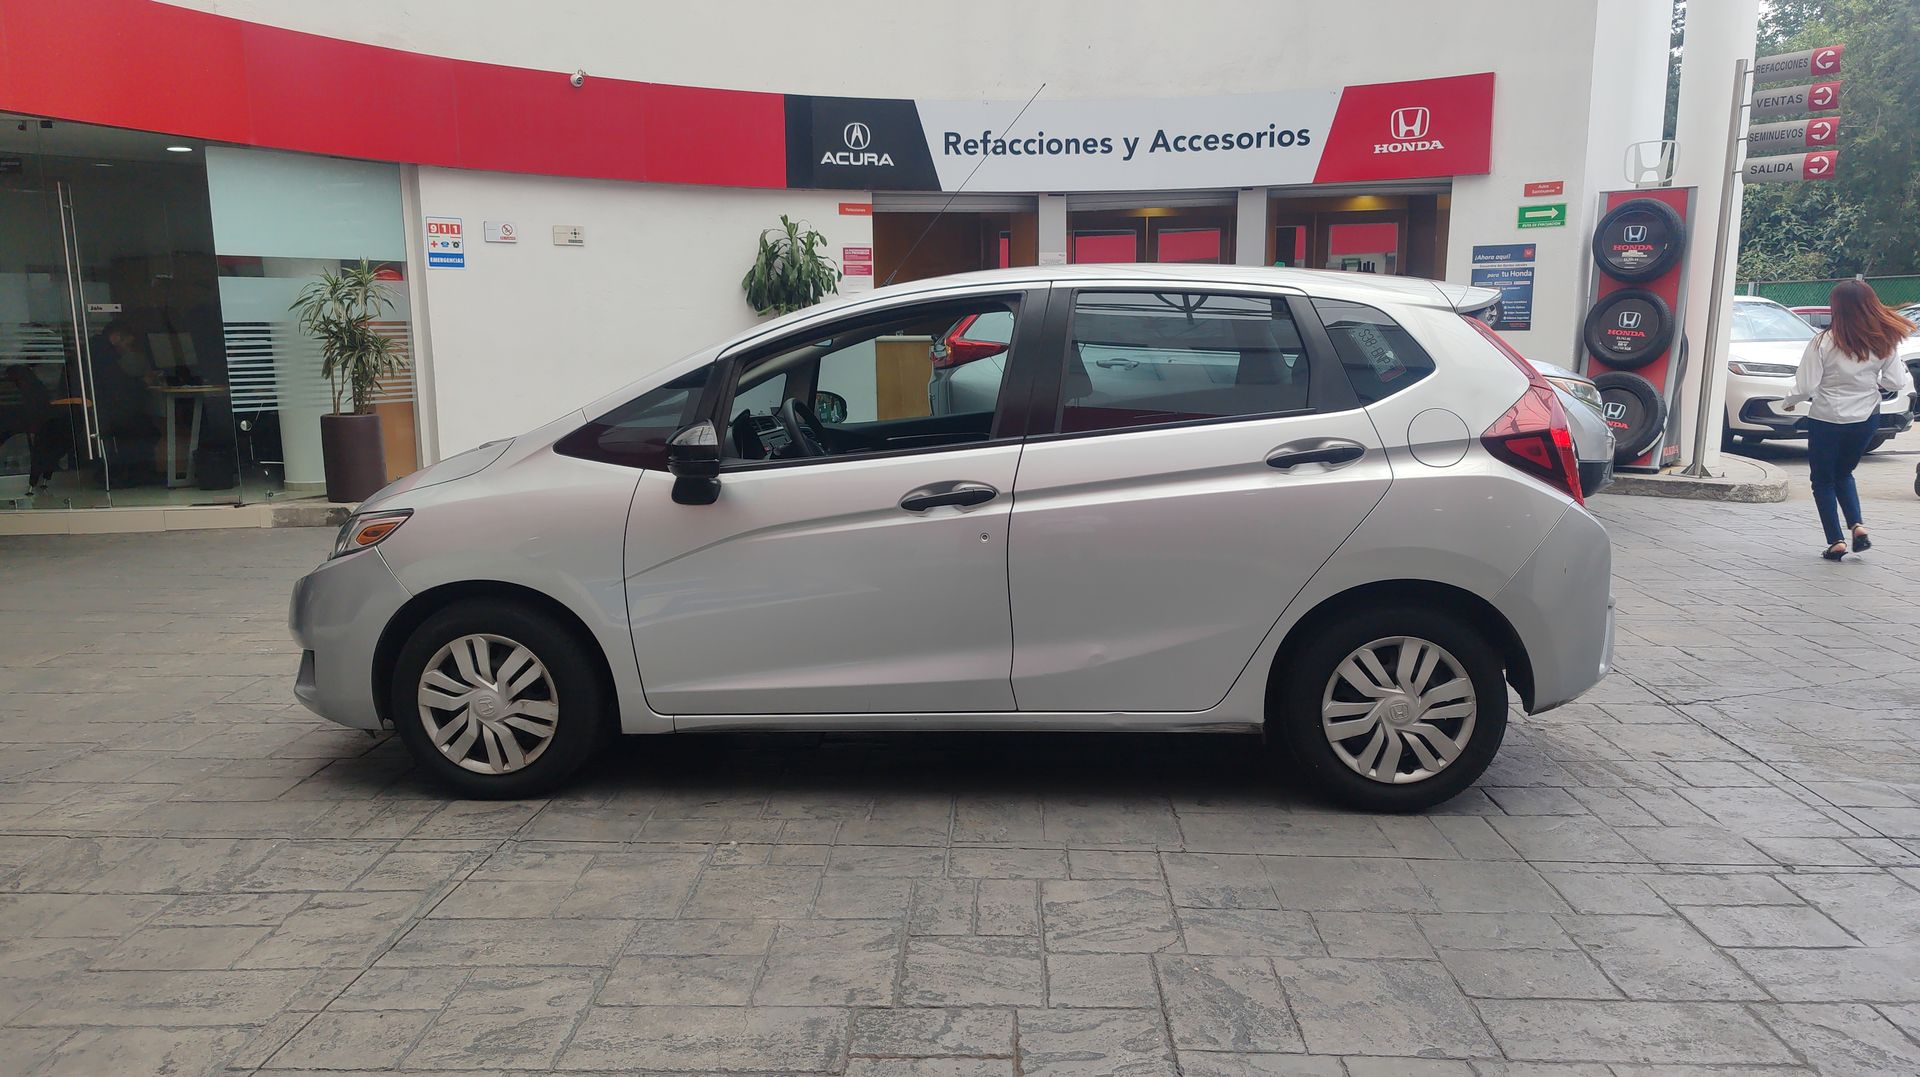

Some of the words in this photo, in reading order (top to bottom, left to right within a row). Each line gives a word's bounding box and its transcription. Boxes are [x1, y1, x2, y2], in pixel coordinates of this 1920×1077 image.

[1756, 58, 1809, 74] REFACCIONES
[1756, 94, 1803, 108] VENTAS
[1748, 127, 1804, 142] SEMINUEVOS
[944, 130, 1113, 156] Refacciones
[1122, 137, 1140, 161] y
[1148, 124, 1311, 153] Accesorios
[1373, 138, 1445, 154] HONDA
[820, 152, 895, 167] ACURA
[1750, 162, 1794, 175] SALIDA
[429, 223, 460, 234] 911
[430, 256, 464, 264] EMERGENCIAS
[1607, 329, 1646, 337] HONDA
